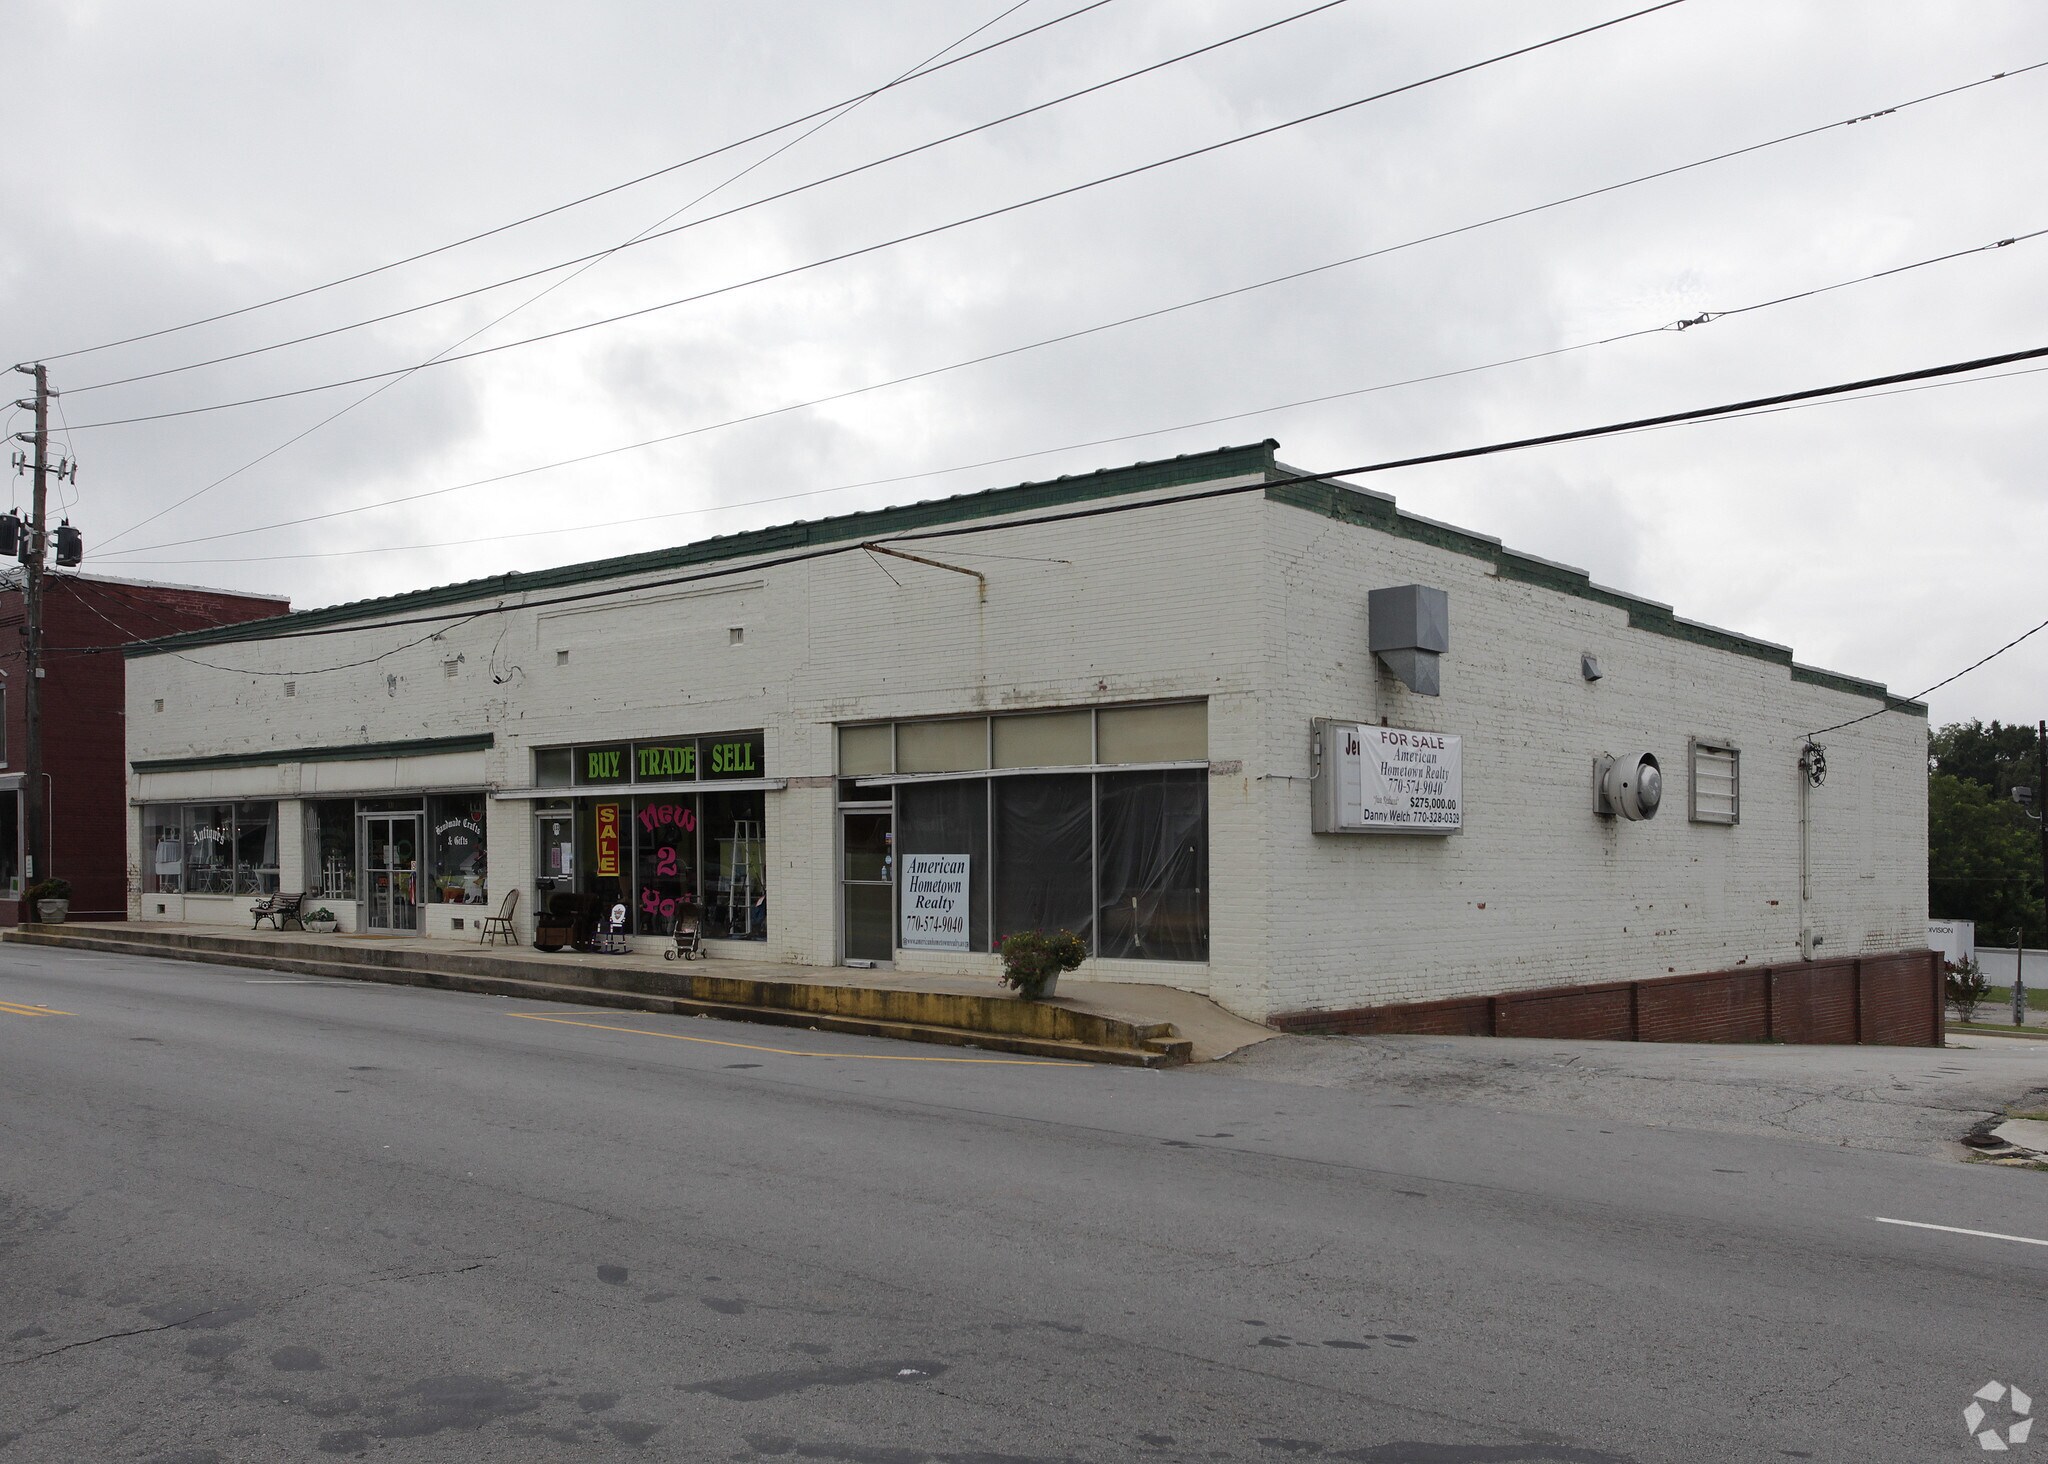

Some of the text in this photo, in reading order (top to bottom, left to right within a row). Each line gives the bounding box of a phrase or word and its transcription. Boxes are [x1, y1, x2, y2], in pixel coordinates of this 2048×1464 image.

[1380, 731, 1445, 750] FOR SALE
[588, 742, 755, 779] BUY TRADE SELL
[1393, 747, 1437, 764] American
[1380, 761, 1450, 783] Hometown Realty
[1388, 778, 1443, 796] 770-574-9040
[1410, 796, 1457, 810] $275,000.00
[1363, 808, 1460, 824] Danny Welch 770-328-0329
[193, 825, 225, 846] Antiques
[435, 817, 481, 836] Handmade Crafts
[453, 835, 469, 846] Gifts
[600, 808, 617, 872] SALE
[656, 846, 678, 877] 2
[906, 856, 965, 874] American
[909, 875, 962, 894] Hometown
[642, 886, 692, 917] Yo
[915, 895, 955, 913] Realty
[906, 915, 964, 934] 770-574-9040
